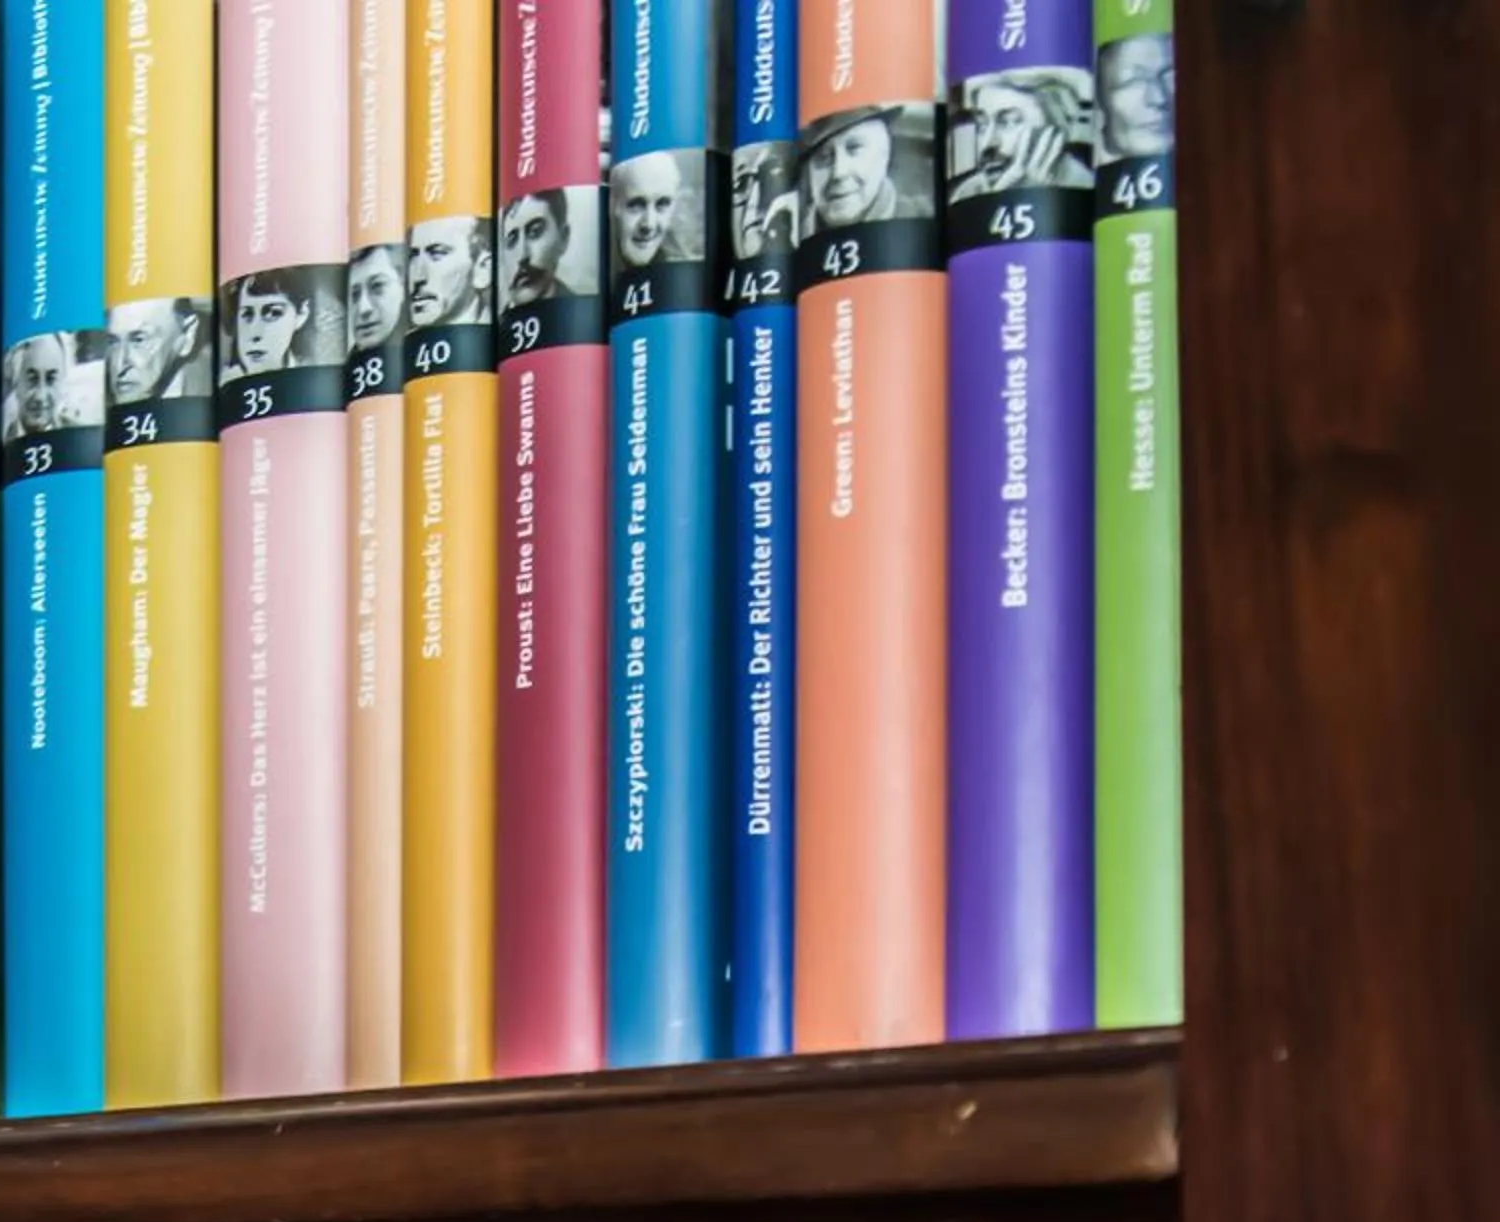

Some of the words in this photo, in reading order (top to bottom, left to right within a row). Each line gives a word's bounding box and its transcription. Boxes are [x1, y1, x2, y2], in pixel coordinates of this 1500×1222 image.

[1113, 168, 1163, 209] 46
[989, 204, 1034, 240] 45
[741, 270, 781, 304] 42
[823, 240, 861, 277] 43
[1126, 232, 1153, 286] Rad
[624, 281, 653, 315] 41
[1001, 262, 1028, 352] Kinder
[415, 339, 451, 373] 40
[510, 317, 541, 351] 39
[832, 298, 853, 426] Leviathan
[1127, 290, 1154, 392] Unterm
[242, 385, 273, 418] 35
[352, 357, 383, 396] 38
[750, 326, 773, 415] Henker
[122, 413, 158, 445] 34
[423, 392, 444, 438] Flat
[516, 370, 535, 467] Swanns
[628, 336, 648, 476] Seidenman
[1000, 356, 1028, 502] Bronsteins
[23, 443, 53, 475] 33
[248, 436, 270, 495] Jäger
[358, 414, 376, 535] Passanten
[750, 421, 773, 475] sein
[830, 431, 854, 518] Green:
[1128, 397, 1154, 492] Hesse:
[128, 463, 151, 541] Magier
[423, 443, 443, 528] Tortilla
[515, 471, 534, 538] Liebe
[627, 481, 646, 535] Frau
[750, 481, 773, 528] und
[30, 492, 46, 612] Allerseelen
[129, 545, 148, 585] Der
[251, 500, 267, 604] einsamer
[515, 542, 534, 595] Eine
[749, 533, 773, 625] Richter
[1000, 507, 1028, 608] Becker:
[421, 532, 444, 659] Steinbeck:
[626, 540, 645, 630] schöne
[128, 590, 151, 707] Maugham:
[250, 610, 266, 645] ein
[515, 601, 534, 689] Proust:
[627, 636, 644, 678] Die
[750, 631, 773, 674] Der
[30, 618, 46, 749] Nooteboom:
[249, 651, 266, 680] ist
[250, 686, 266, 738] Herz
[250, 744, 266, 787] Das
[625, 683, 648, 852] Szczypiorski:
[748, 681, 772, 835] Dürrenmatt:
[250, 793, 267, 913] McCullers:
